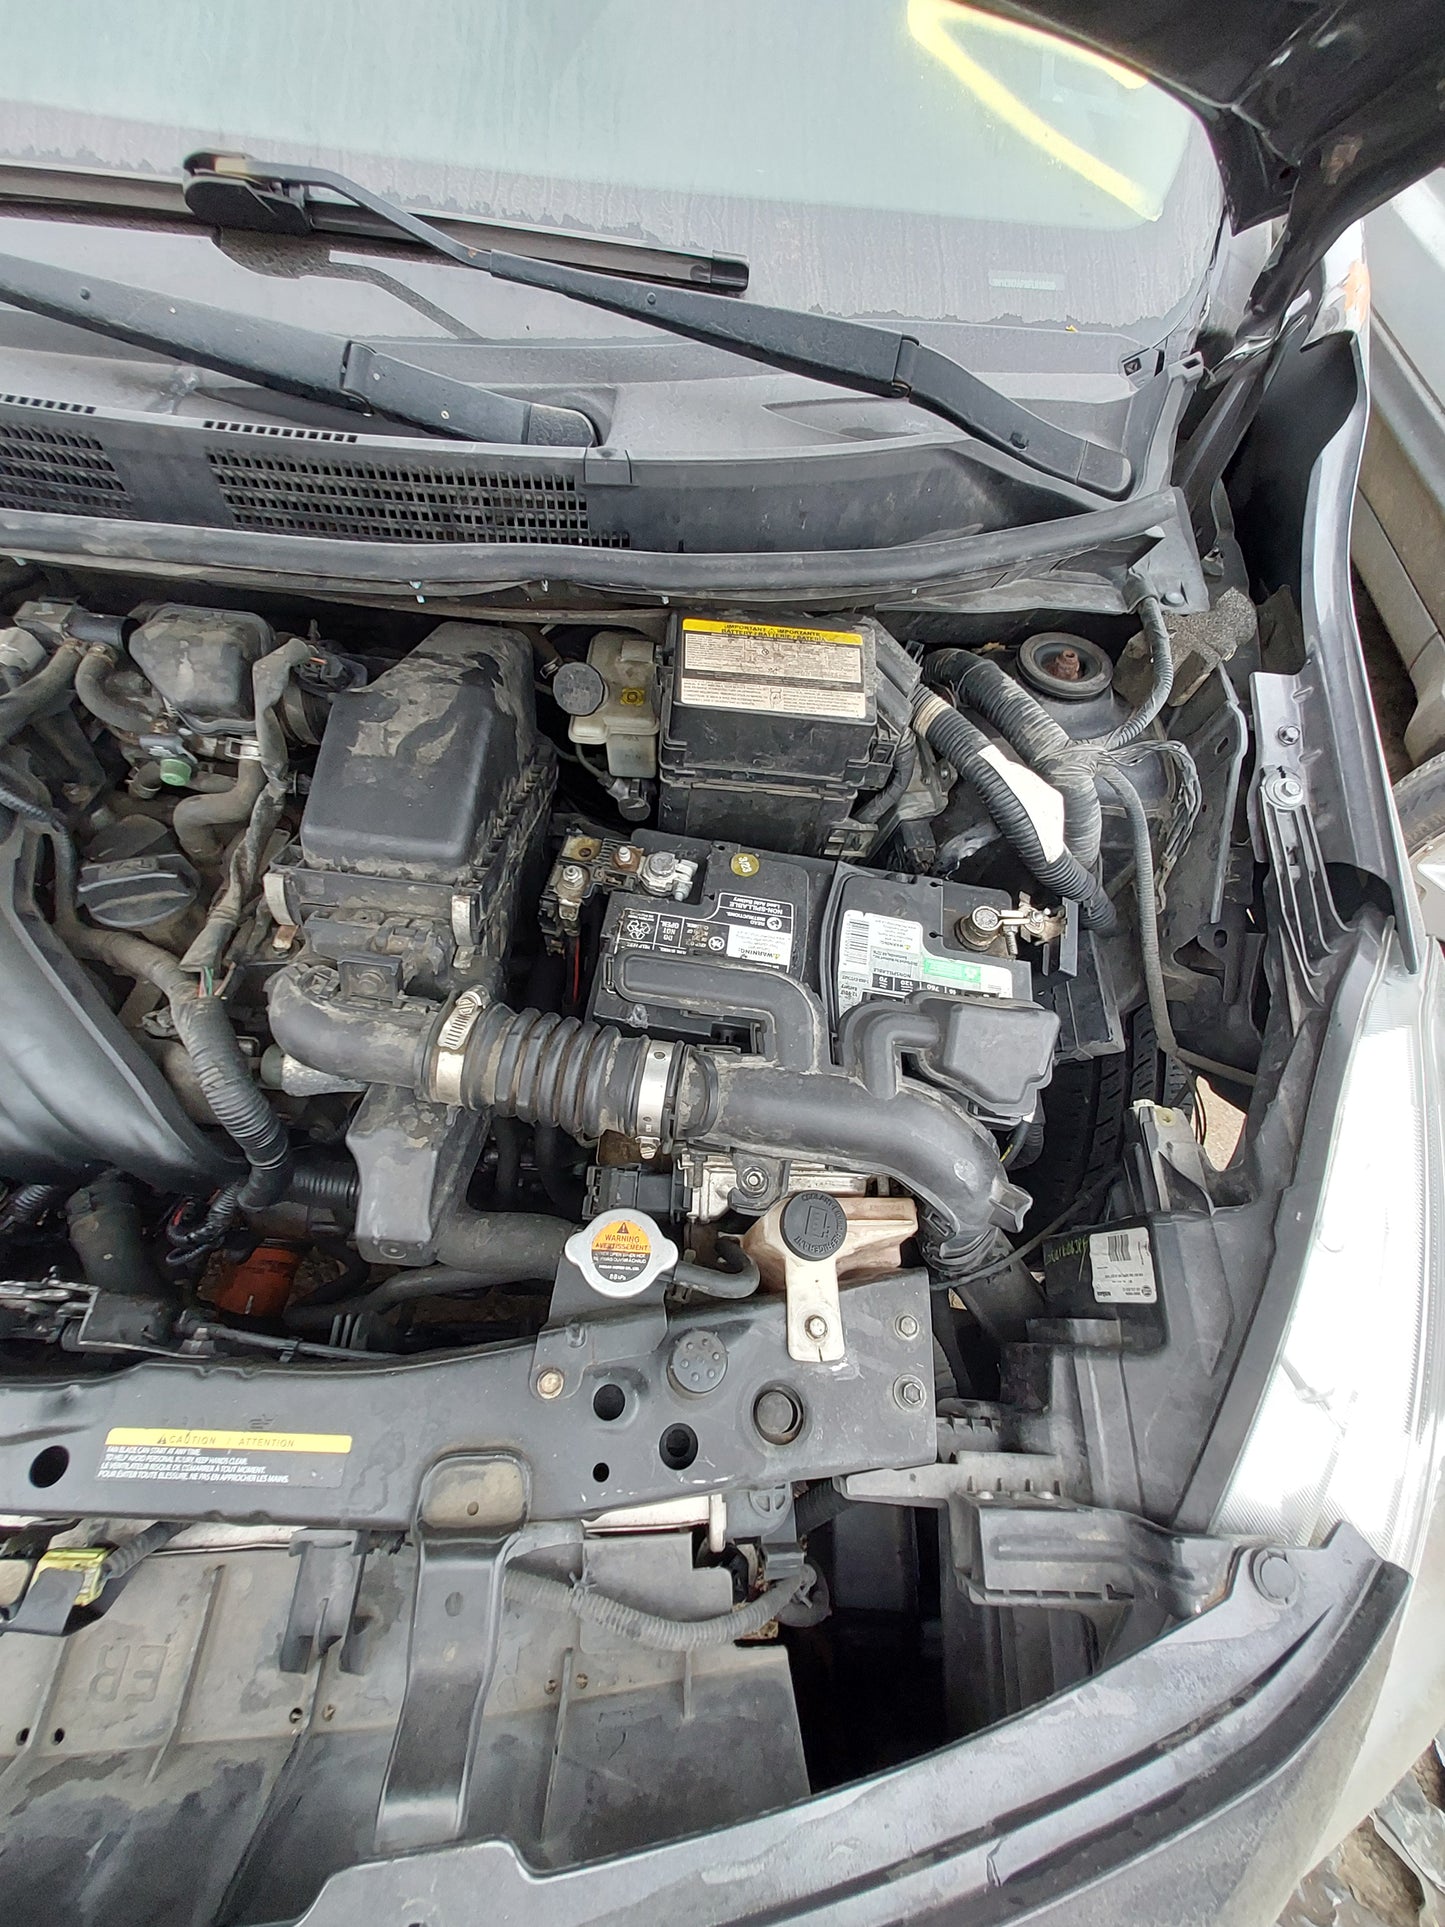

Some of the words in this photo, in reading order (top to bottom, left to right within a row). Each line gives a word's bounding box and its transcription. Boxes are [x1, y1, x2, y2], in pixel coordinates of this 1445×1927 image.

[733, 897, 753, 905] Battery
[729, 901, 783, 915] NON-SPILLABLE
[662, 927, 676, 935] NOT
[873, 968, 911, 978] NONSPILLABLE
[900, 979, 914, 987] 120
[926, 983, 940, 992] 760
[605, 1234, 640, 1243] WARNING
[595, 1243, 648, 1251] AVERTISSEMENT
[168, 1434, 216, 1445] CAUTION
[238, 1438, 295, 1447] ATTENTION
